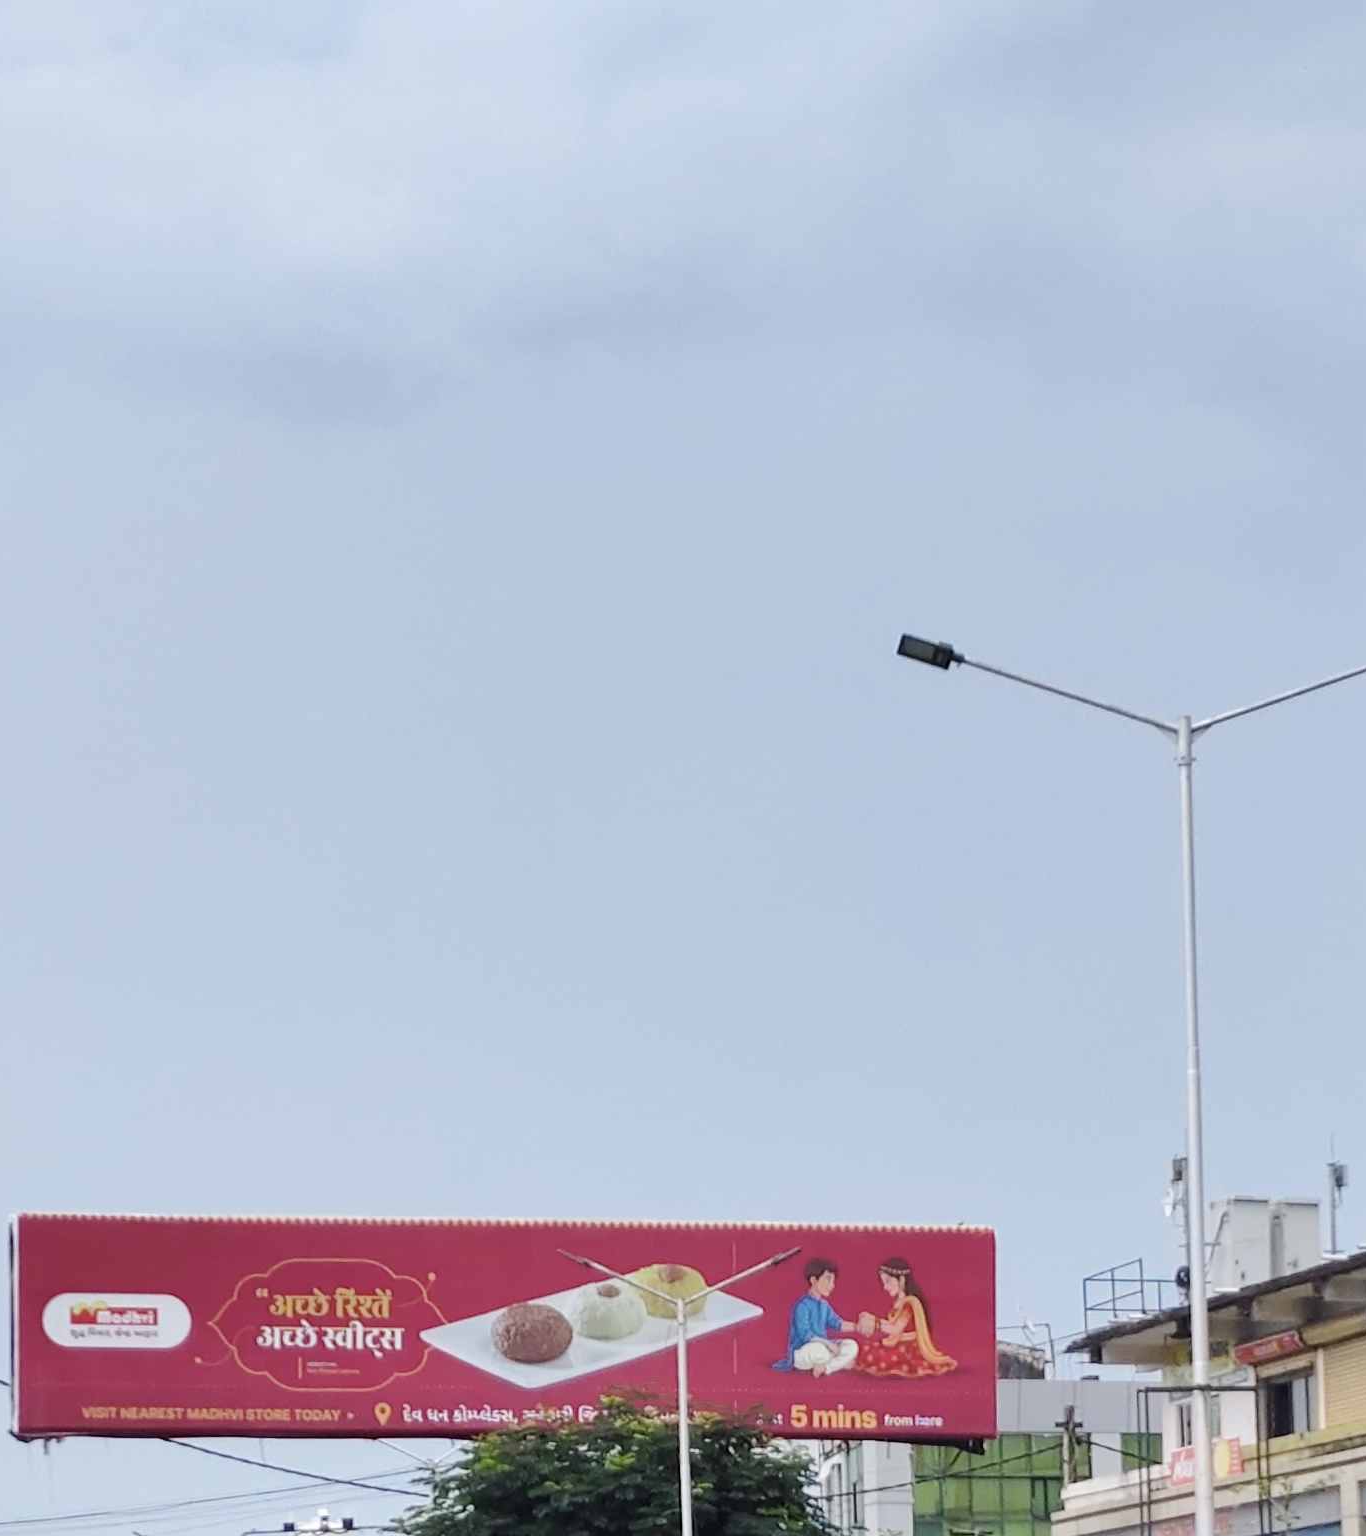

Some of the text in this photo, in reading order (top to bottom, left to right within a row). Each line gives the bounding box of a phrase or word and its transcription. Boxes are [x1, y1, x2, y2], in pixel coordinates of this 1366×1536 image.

[96, 1309, 154, 1324] Madhvi
[256, 1319, 405, 1359] अच्छे स्वीट्स
[82, 1407, 341, 1422] VISIT NEAREST MADHVI STORE TODAY
[790, 1404, 808, 1429] 5
[812, 1404, 877, 1429] mins
[884, 1414, 913, 1427] from
